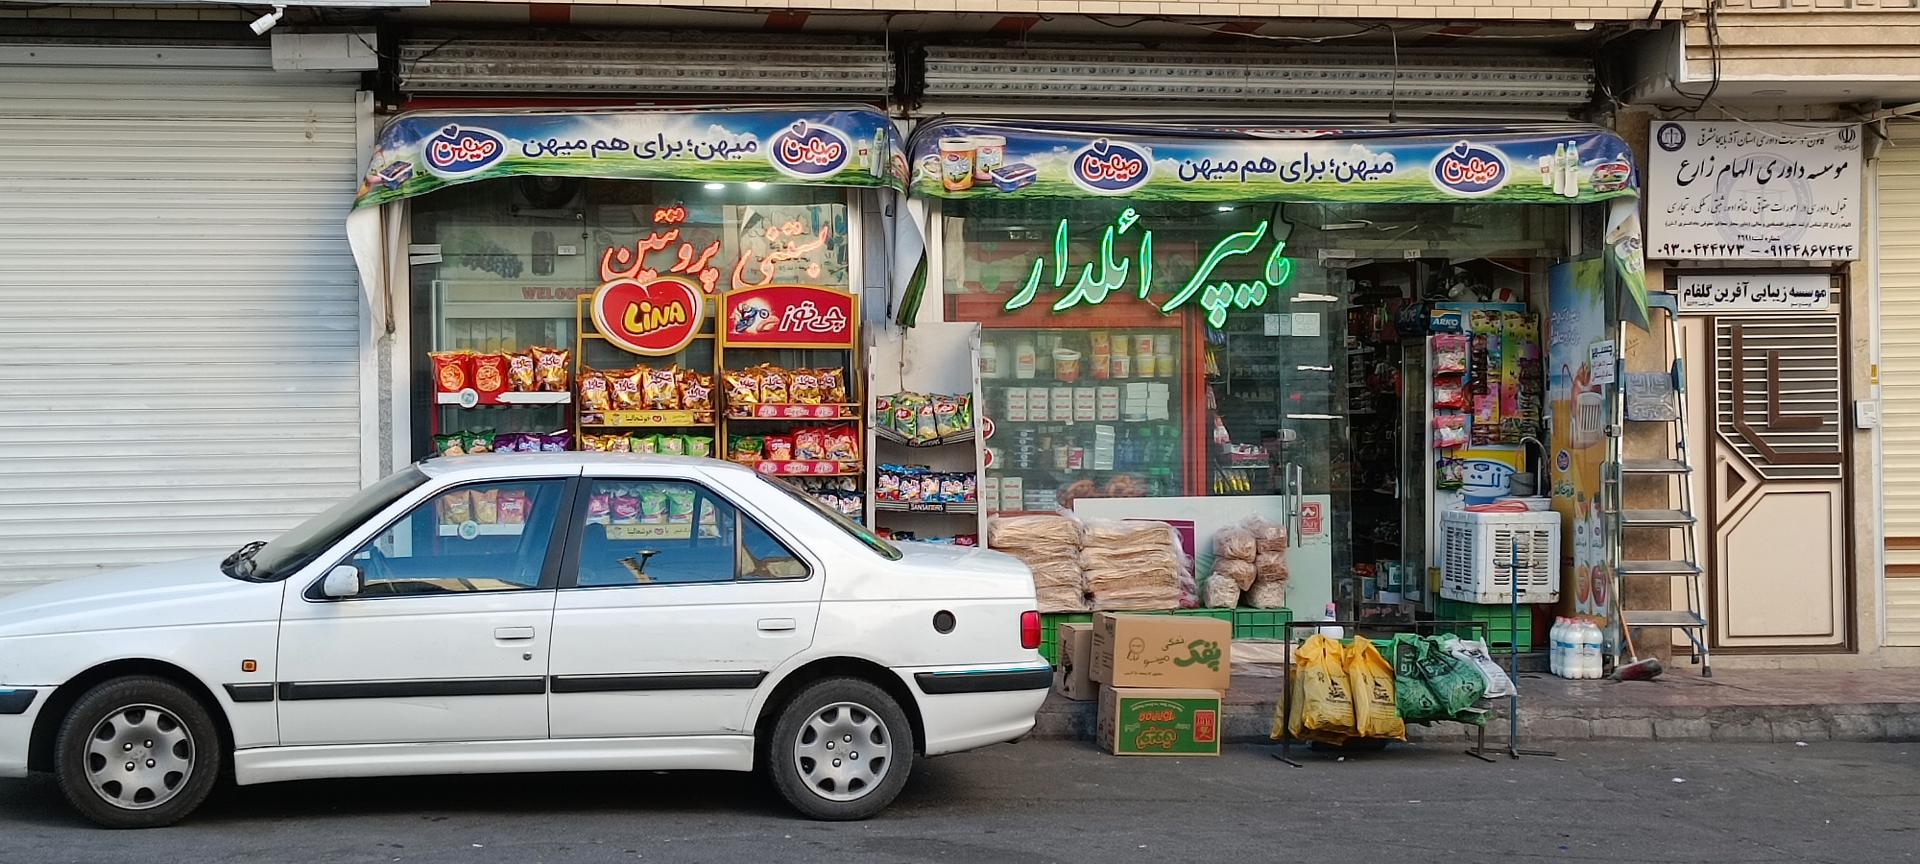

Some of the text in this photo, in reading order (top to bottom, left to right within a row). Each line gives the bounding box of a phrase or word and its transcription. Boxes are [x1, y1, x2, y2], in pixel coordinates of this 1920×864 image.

[433, 125, 497, 167] میهن
[522, 138, 588, 158] میهن
[591, 137, 630, 159] هم
[633, 132, 683, 160] برای
[782, 121, 842, 166] میهن
[1083, 140, 1142, 181] میهن
[1178, 158, 1238, 182] میهن
[1241, 156, 1277, 183] هم
[1280, 152, 1326, 183] برای
[1443, 142, 1499, 184] میهن
[1676, 155, 1848, 194] موسسه داوری الهام زارع
[1830, 197, 1848, 219] قبول
[732, 222, 829, 290] بستنی
[1683, 281, 1827, 303] موسسه زیبایی آفرین گلفام
[622, 301, 688, 334] LINA
[1432, 318, 1458, 326] ARKO
[1174, 639, 1222, 672] پفک
